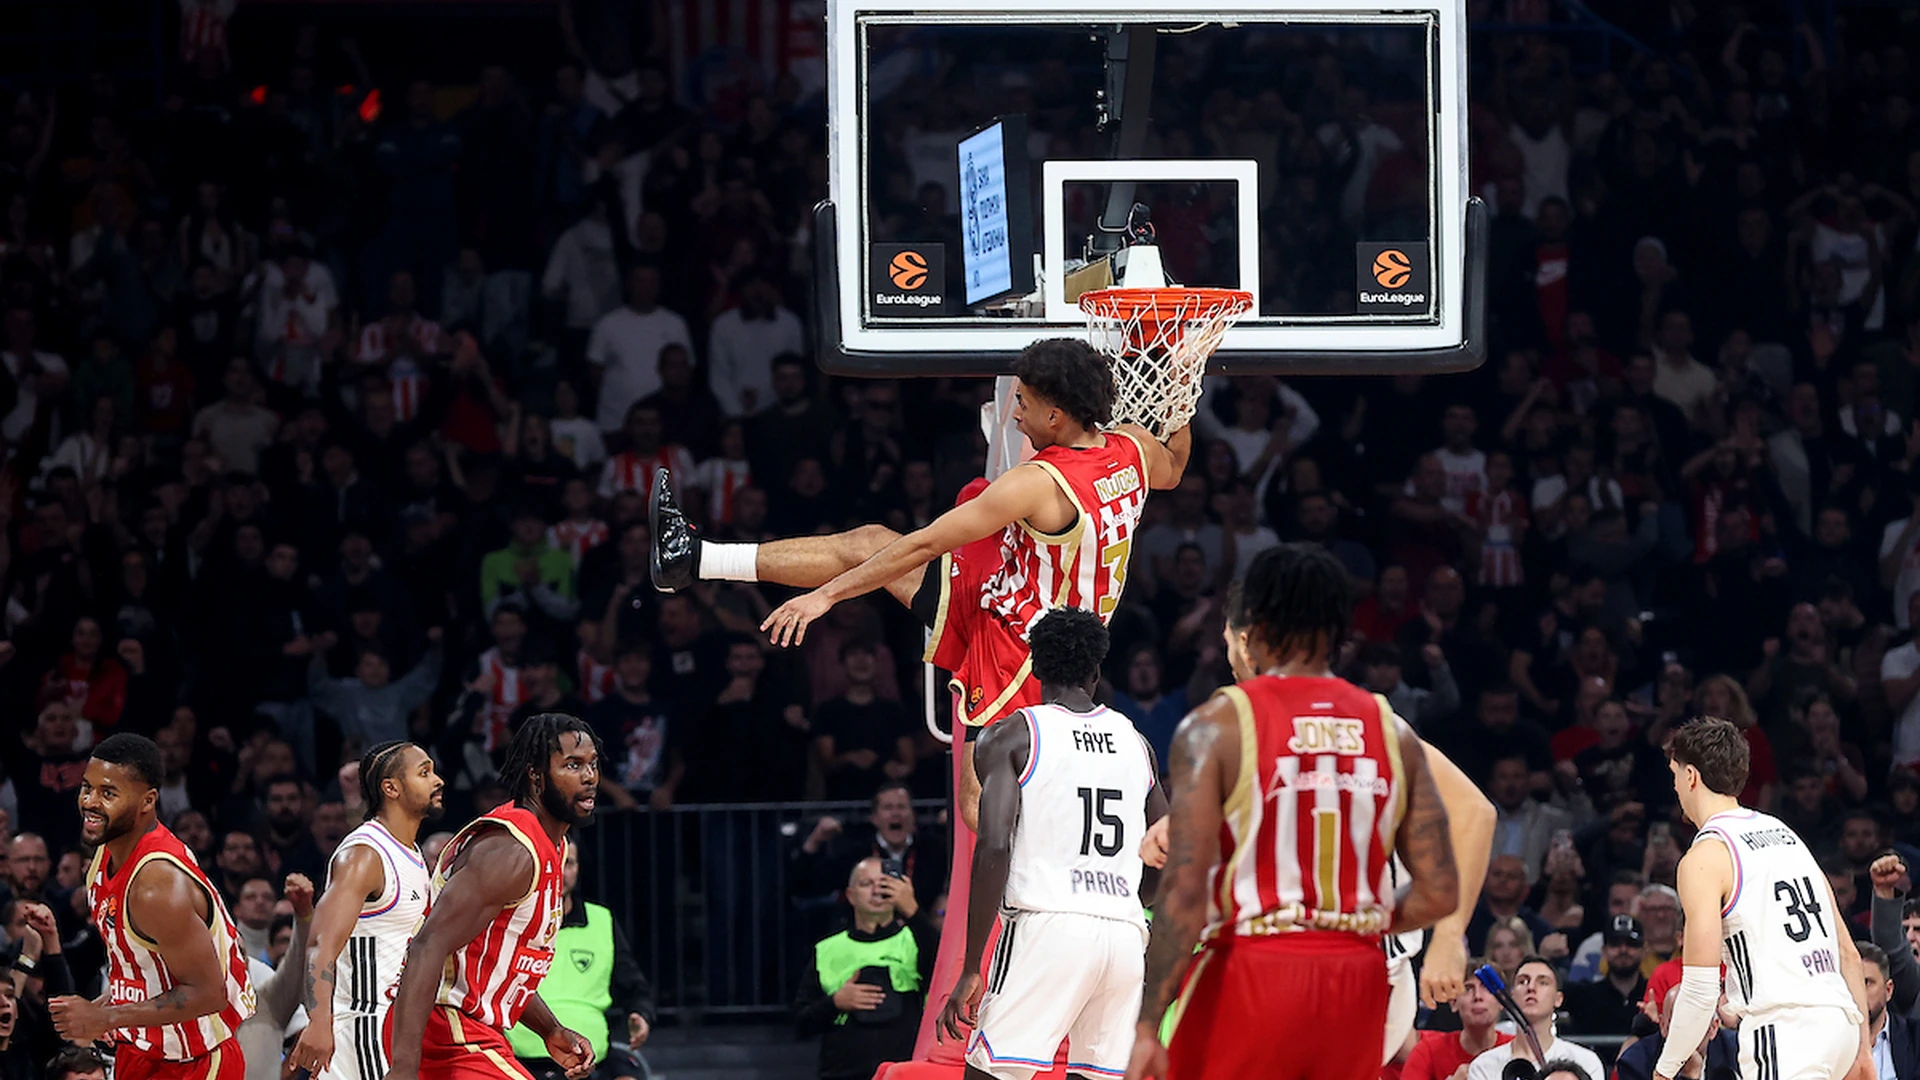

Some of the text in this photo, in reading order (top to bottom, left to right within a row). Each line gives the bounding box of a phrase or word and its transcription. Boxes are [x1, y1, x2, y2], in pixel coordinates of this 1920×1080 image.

[876, 293, 942, 307] EuroLeague
[1360, 292, 1425, 306] EuroLeague
[1101, 538, 1130, 614] 3
[1072, 729, 1117, 754] FAYE
[1290, 718, 1362, 753] JONES
[1077, 787, 1124, 857] 15
[1070, 869, 1131, 897] PARIS
[1774, 876, 1828, 943] 34
[110, 979, 145, 1003] dian
